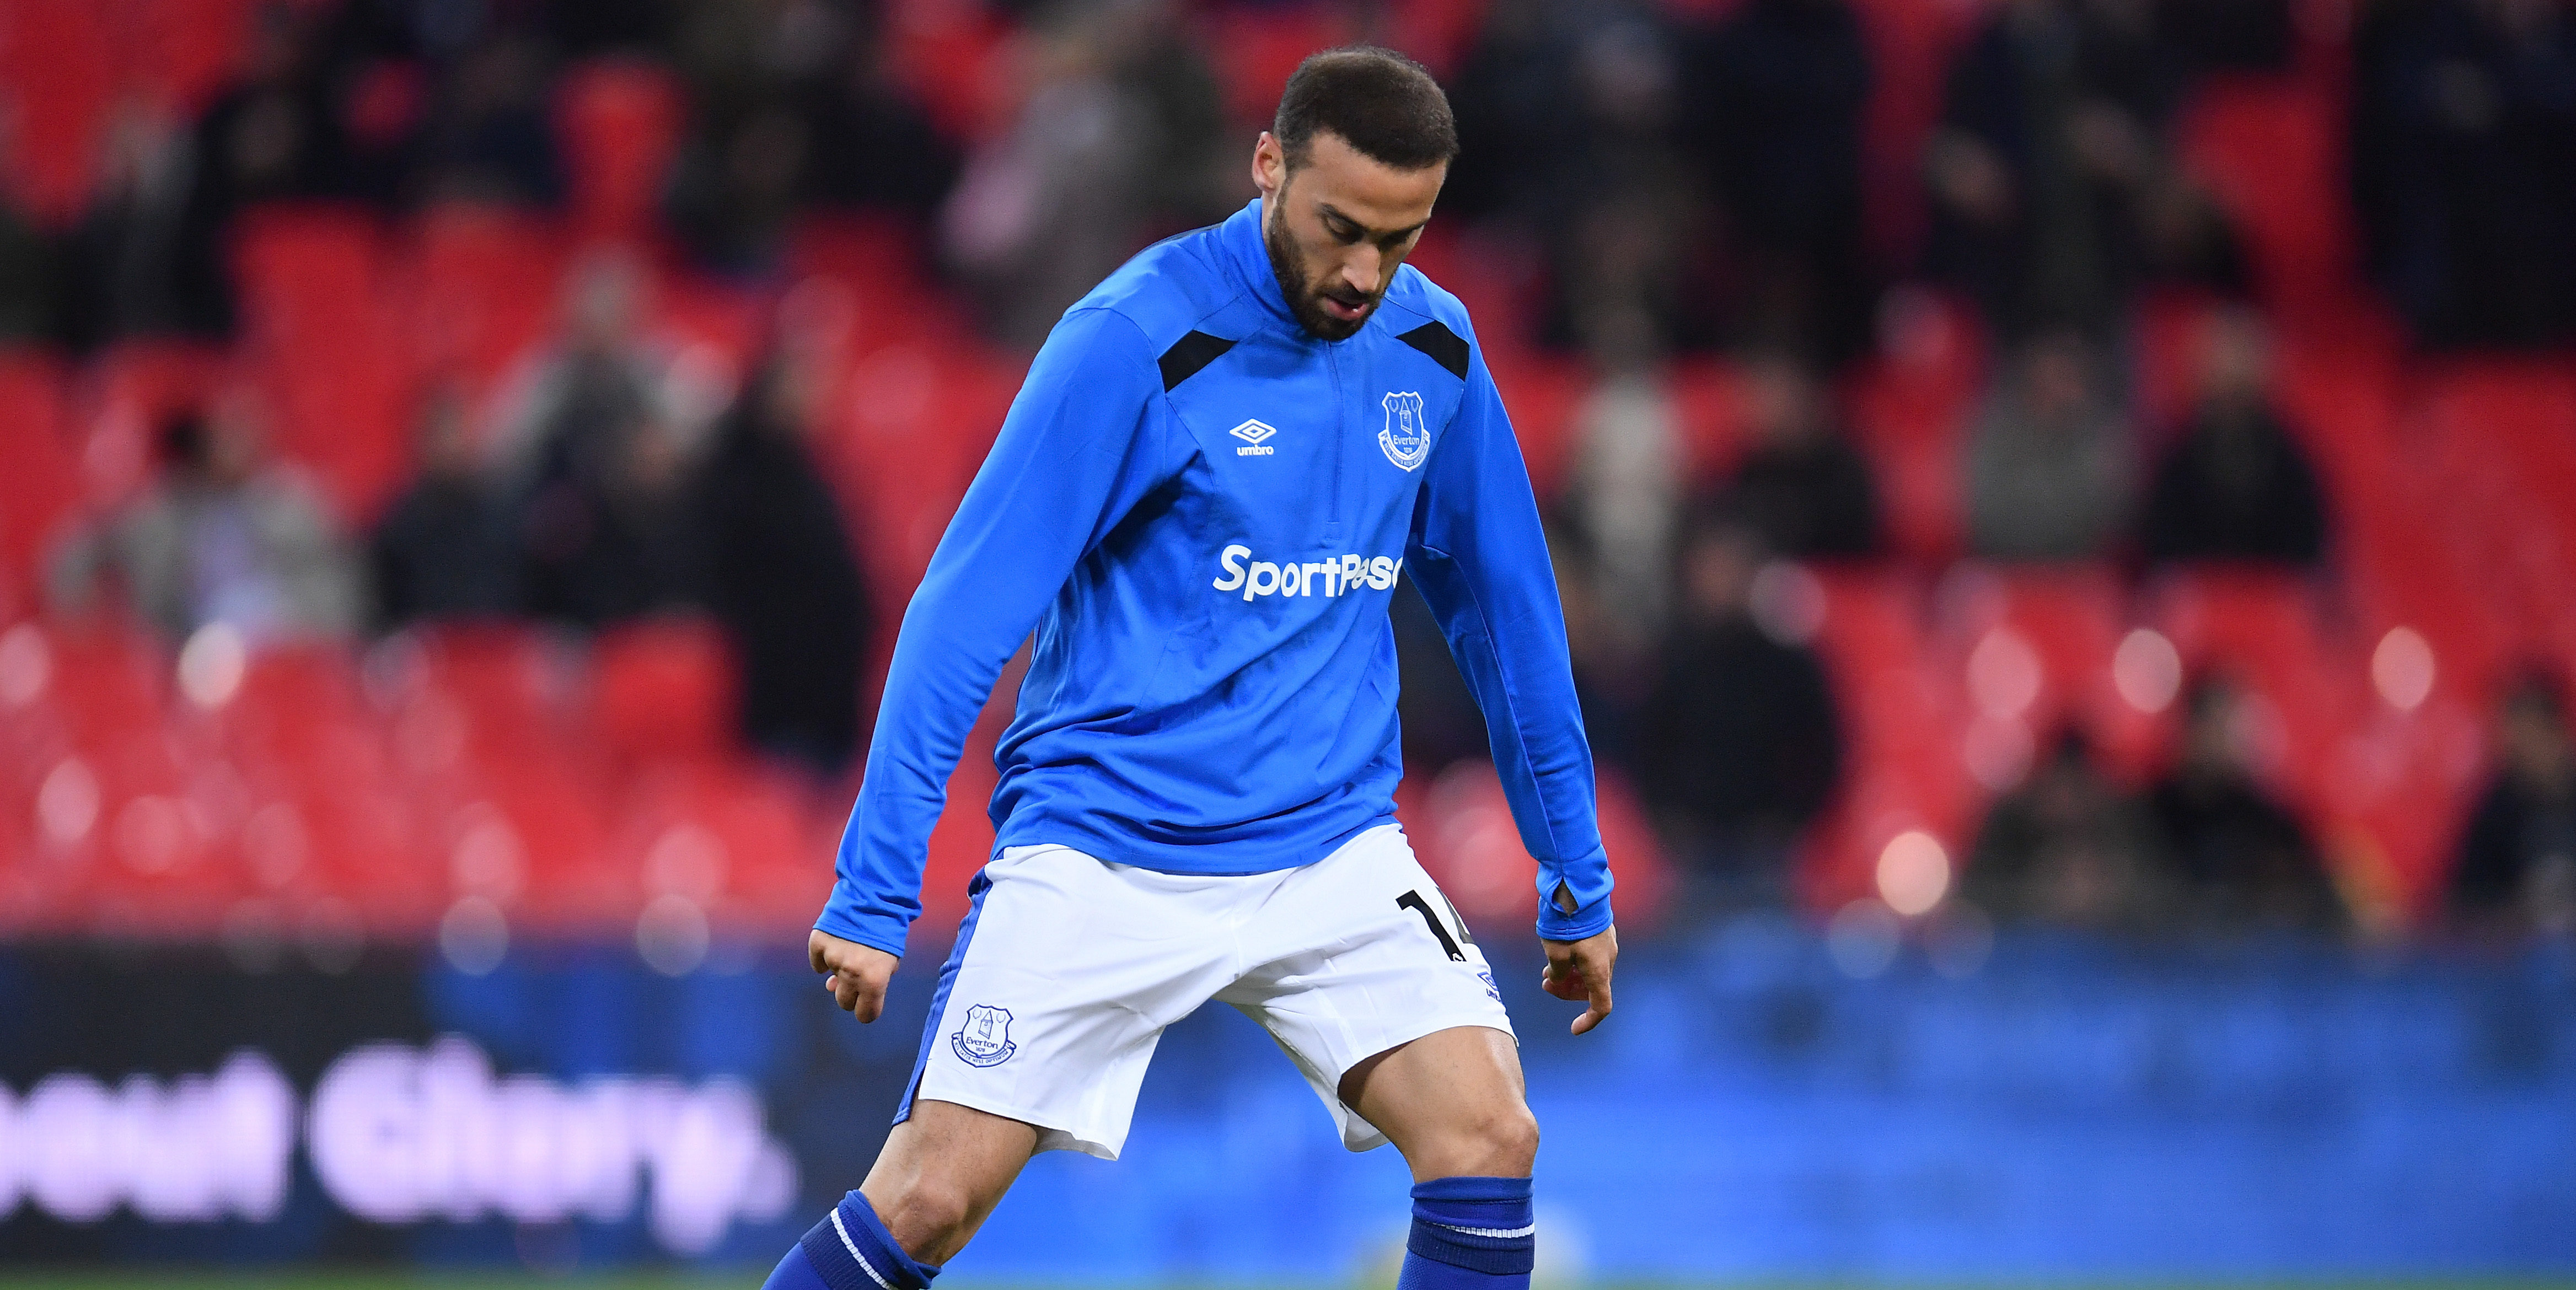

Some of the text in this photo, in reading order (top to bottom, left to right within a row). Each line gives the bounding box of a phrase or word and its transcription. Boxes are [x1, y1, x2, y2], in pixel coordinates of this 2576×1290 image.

[1393, 434, 1420, 445] Everton
[1237, 444, 1274, 456] umbro
[1486, 988, 1502, 1004] umb
[966, 1036, 998, 1049] Everton
